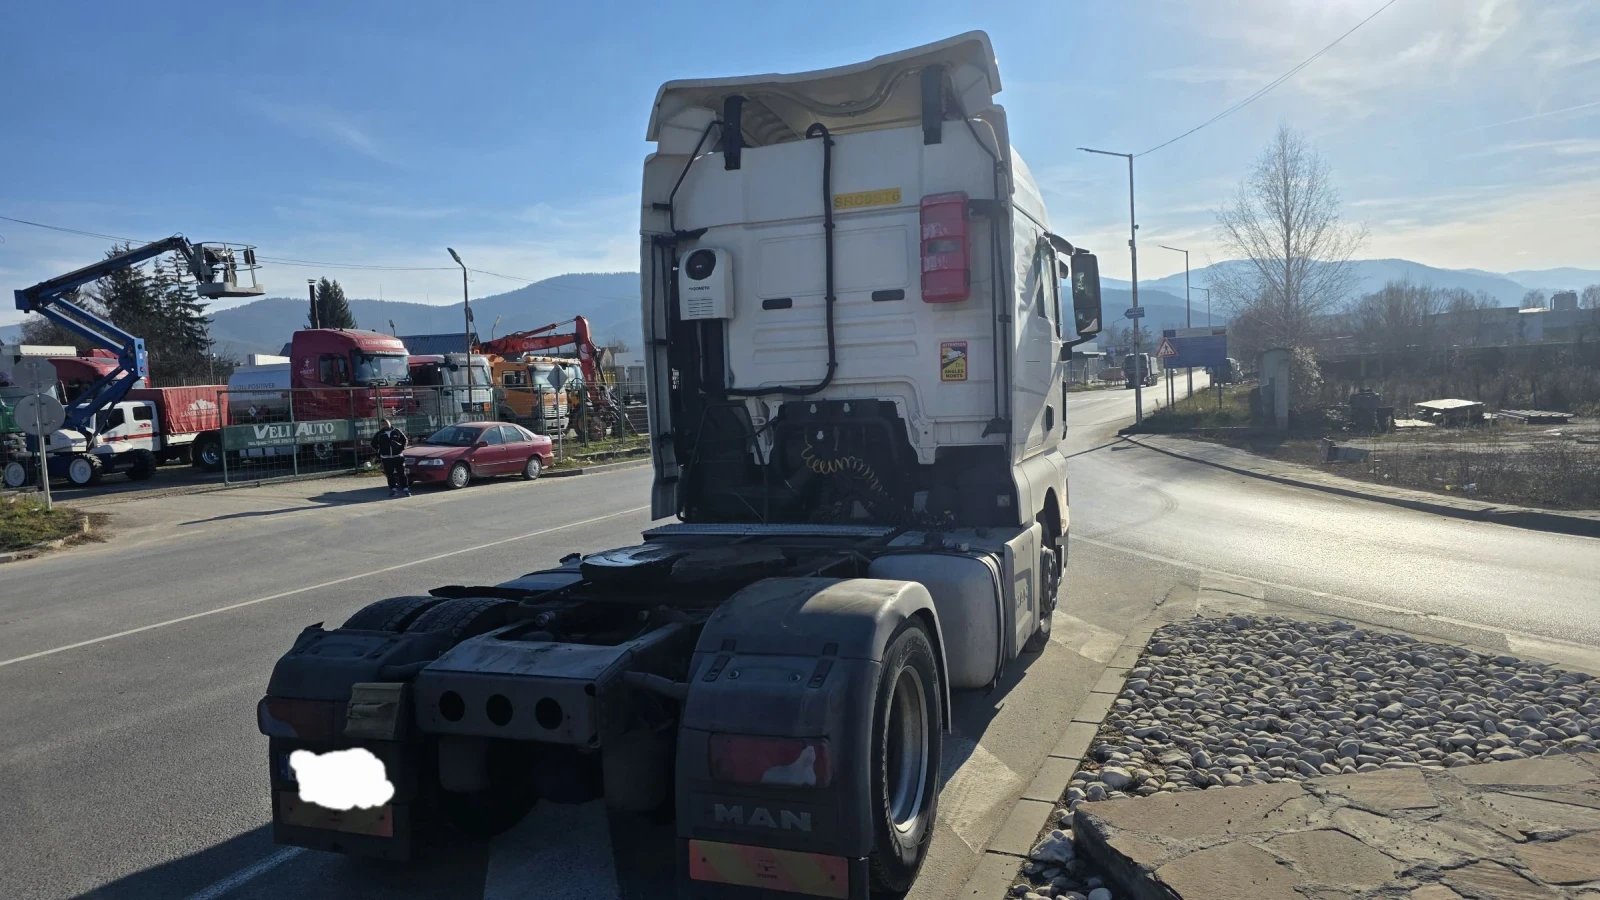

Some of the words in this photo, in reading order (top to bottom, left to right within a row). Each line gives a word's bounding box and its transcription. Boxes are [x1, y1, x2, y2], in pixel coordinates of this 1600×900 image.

[247, 382, 276, 390] POSITIVER
[253, 424, 291, 439] VELI
[294, 422, 334, 436] AUTO
[714, 803, 811, 831] MAN
